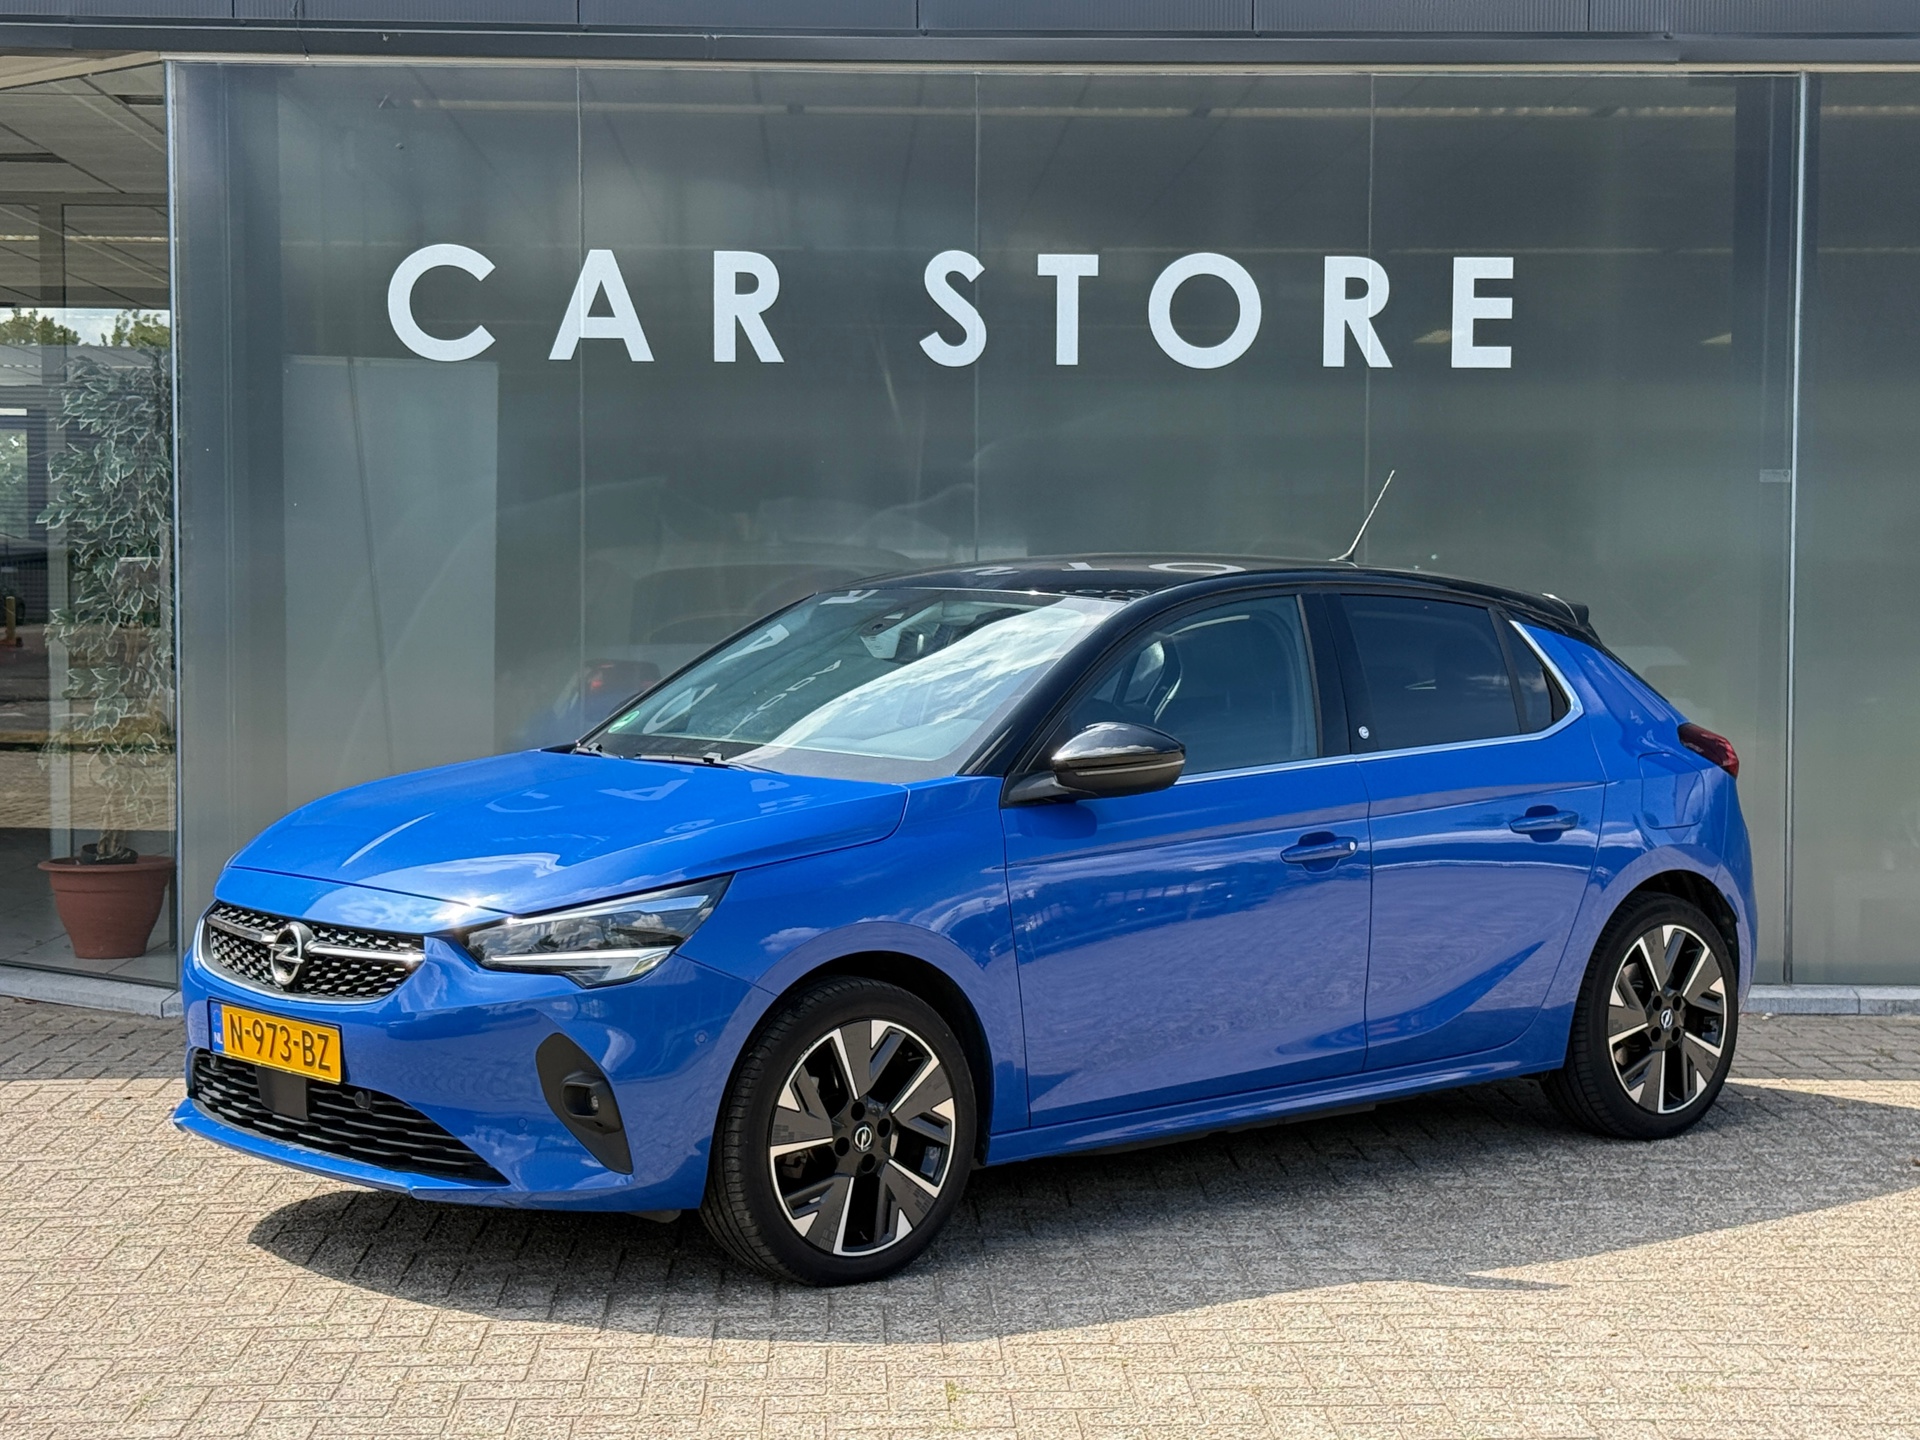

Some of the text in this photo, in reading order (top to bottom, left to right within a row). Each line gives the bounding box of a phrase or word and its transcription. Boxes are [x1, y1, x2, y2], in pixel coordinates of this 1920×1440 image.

[387, 243, 1515, 369] CAR STORE
[213, 1031, 223, 1044] NL
[229, 1013, 331, 1071] N-973-BZ
